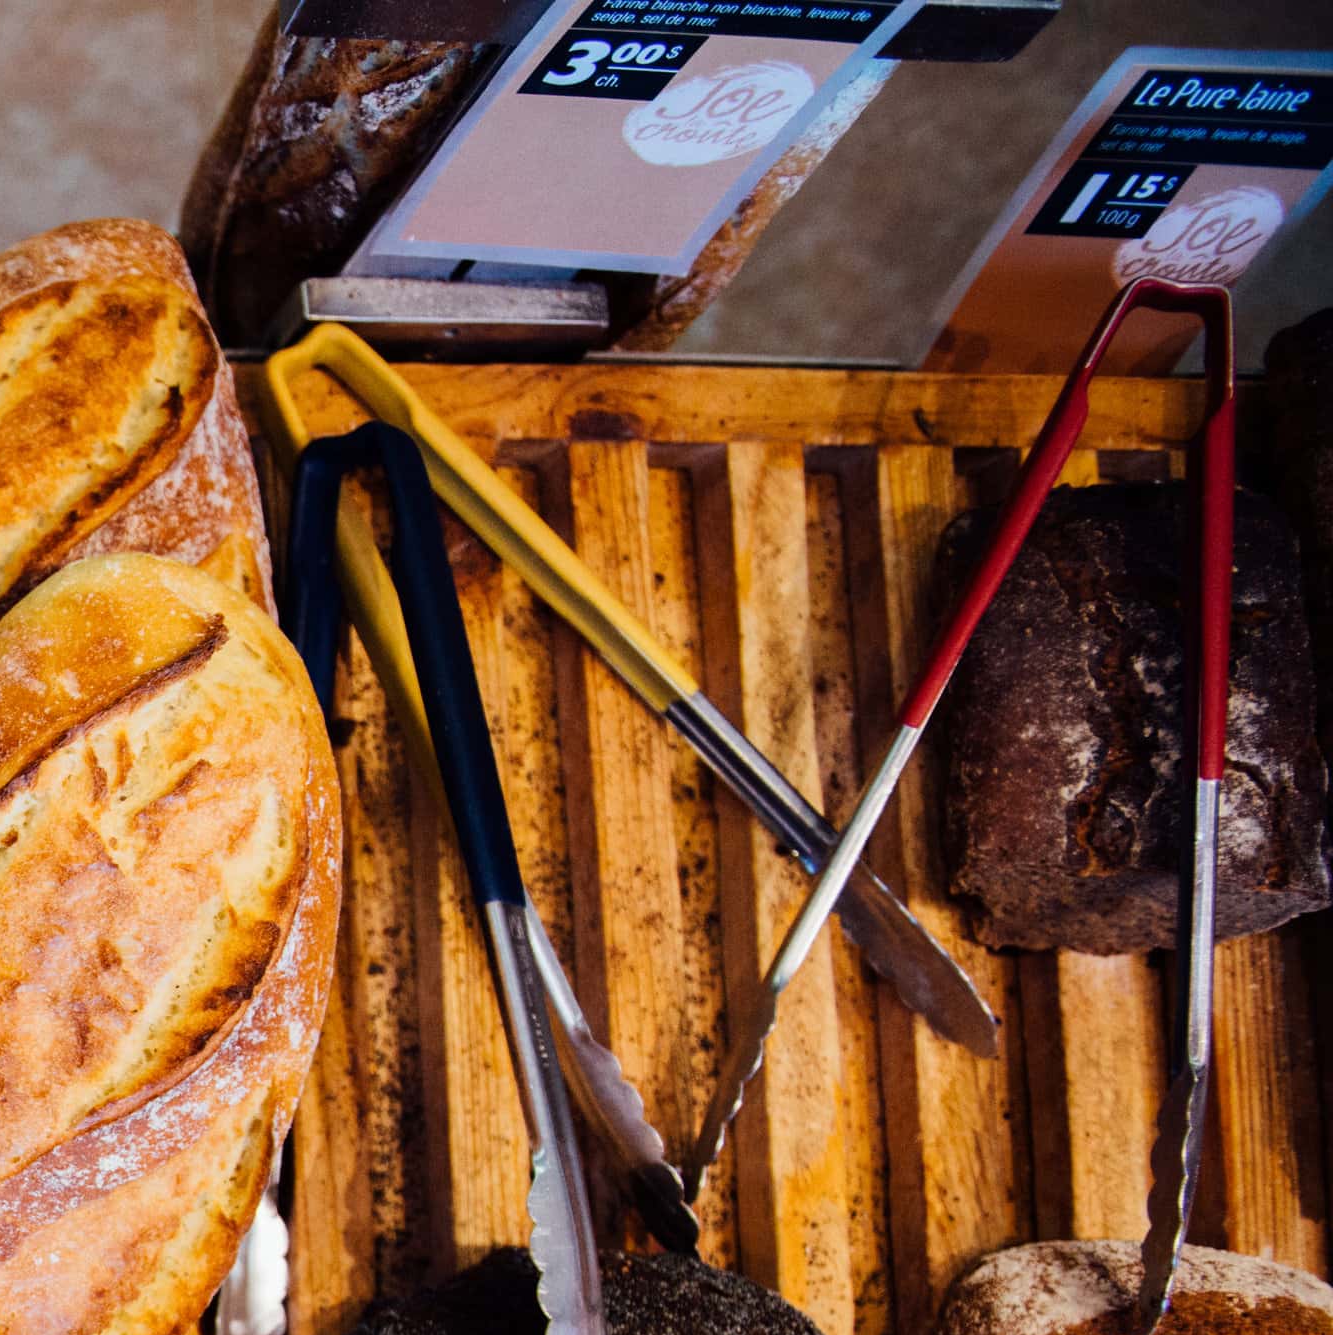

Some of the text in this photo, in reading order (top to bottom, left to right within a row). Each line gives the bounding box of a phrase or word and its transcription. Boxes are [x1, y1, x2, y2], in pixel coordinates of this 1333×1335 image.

[640, 12, 664, 25] sel
[665, 14, 685, 26] de
[651, 0, 707, 13] blanche
[710, 4, 739, 15] non
[808, 8, 851, 21] levain
[852, 10, 872, 22] de
[594, 73, 619, 88] ch.
[1133, 77, 1311, 113] Le Pure-laine
[654, 78, 792, 123] Joe
[1141, 204, 1263, 254] Joe
